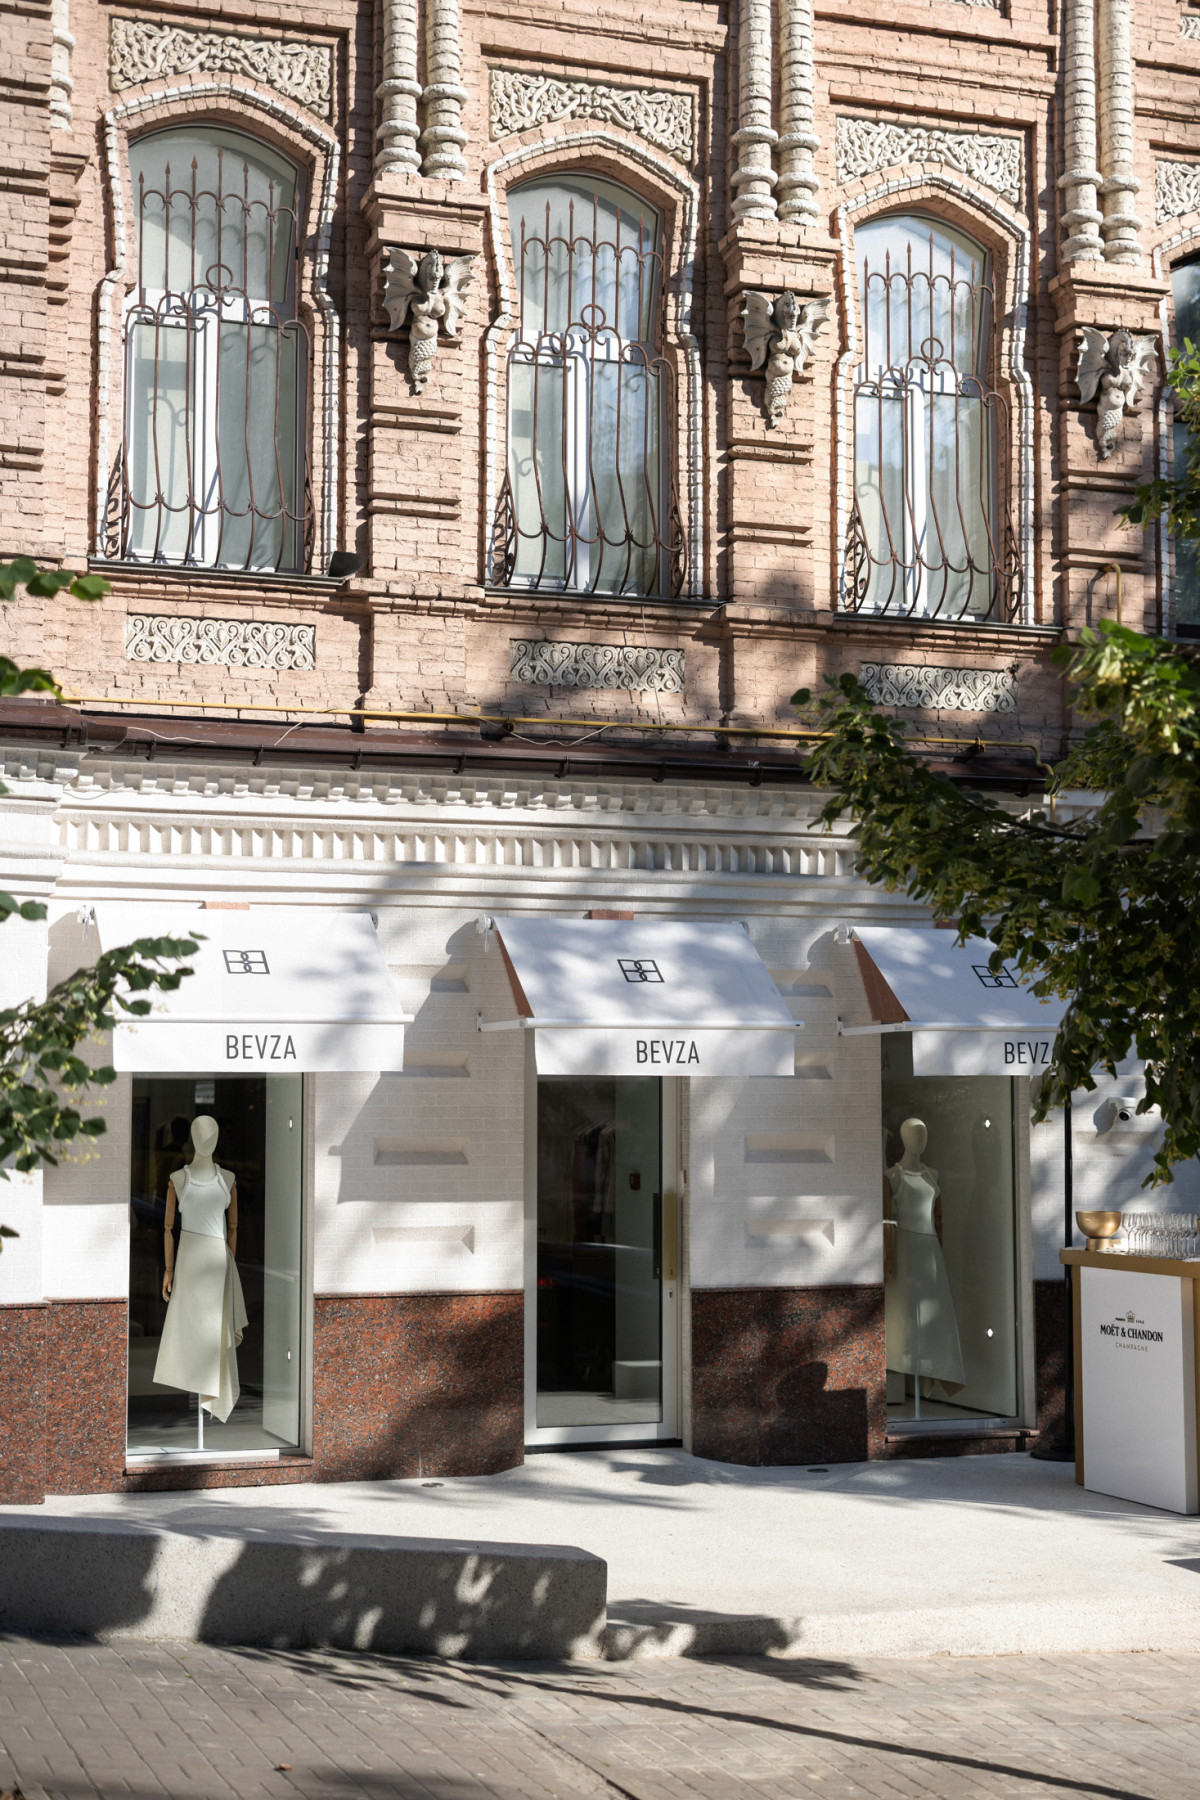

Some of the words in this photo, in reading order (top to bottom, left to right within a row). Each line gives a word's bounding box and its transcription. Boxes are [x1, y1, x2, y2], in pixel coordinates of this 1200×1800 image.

[226, 1034, 297, 1060] BEVZA
[636, 1040, 700, 1064] BEVZA
[1004, 1042, 1054, 1065] BEVZ
[1100, 1323, 1119, 1337] MOËT
[1121, 1326, 1127, 1338] &
[1127, 1327, 1164, 1342] CHANDON
